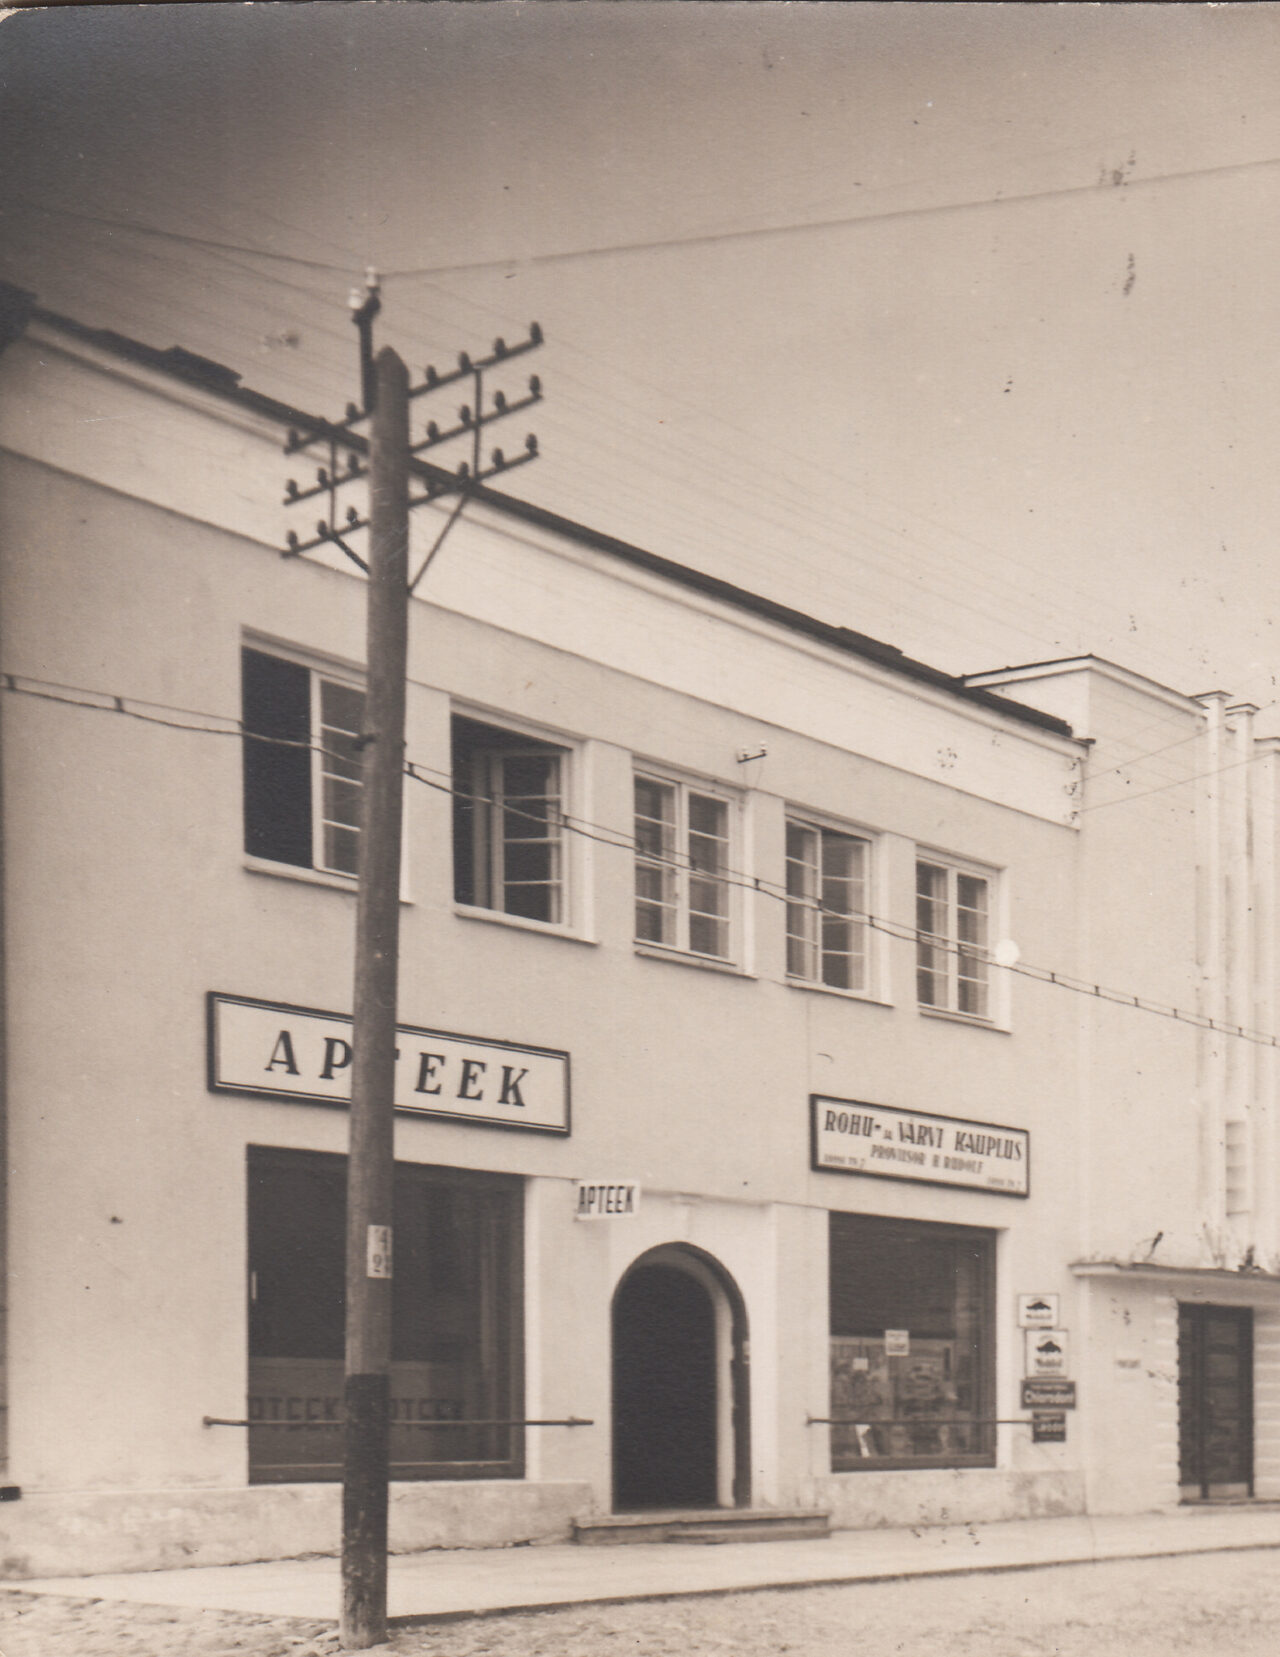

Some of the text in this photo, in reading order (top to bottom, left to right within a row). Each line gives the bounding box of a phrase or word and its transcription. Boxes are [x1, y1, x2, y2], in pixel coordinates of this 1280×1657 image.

[264, 1030, 530, 1107] APEEK
[955, 1131, 1021, 1160] KAUPLUS
[577, 1186, 635, 1213] APTEEK
